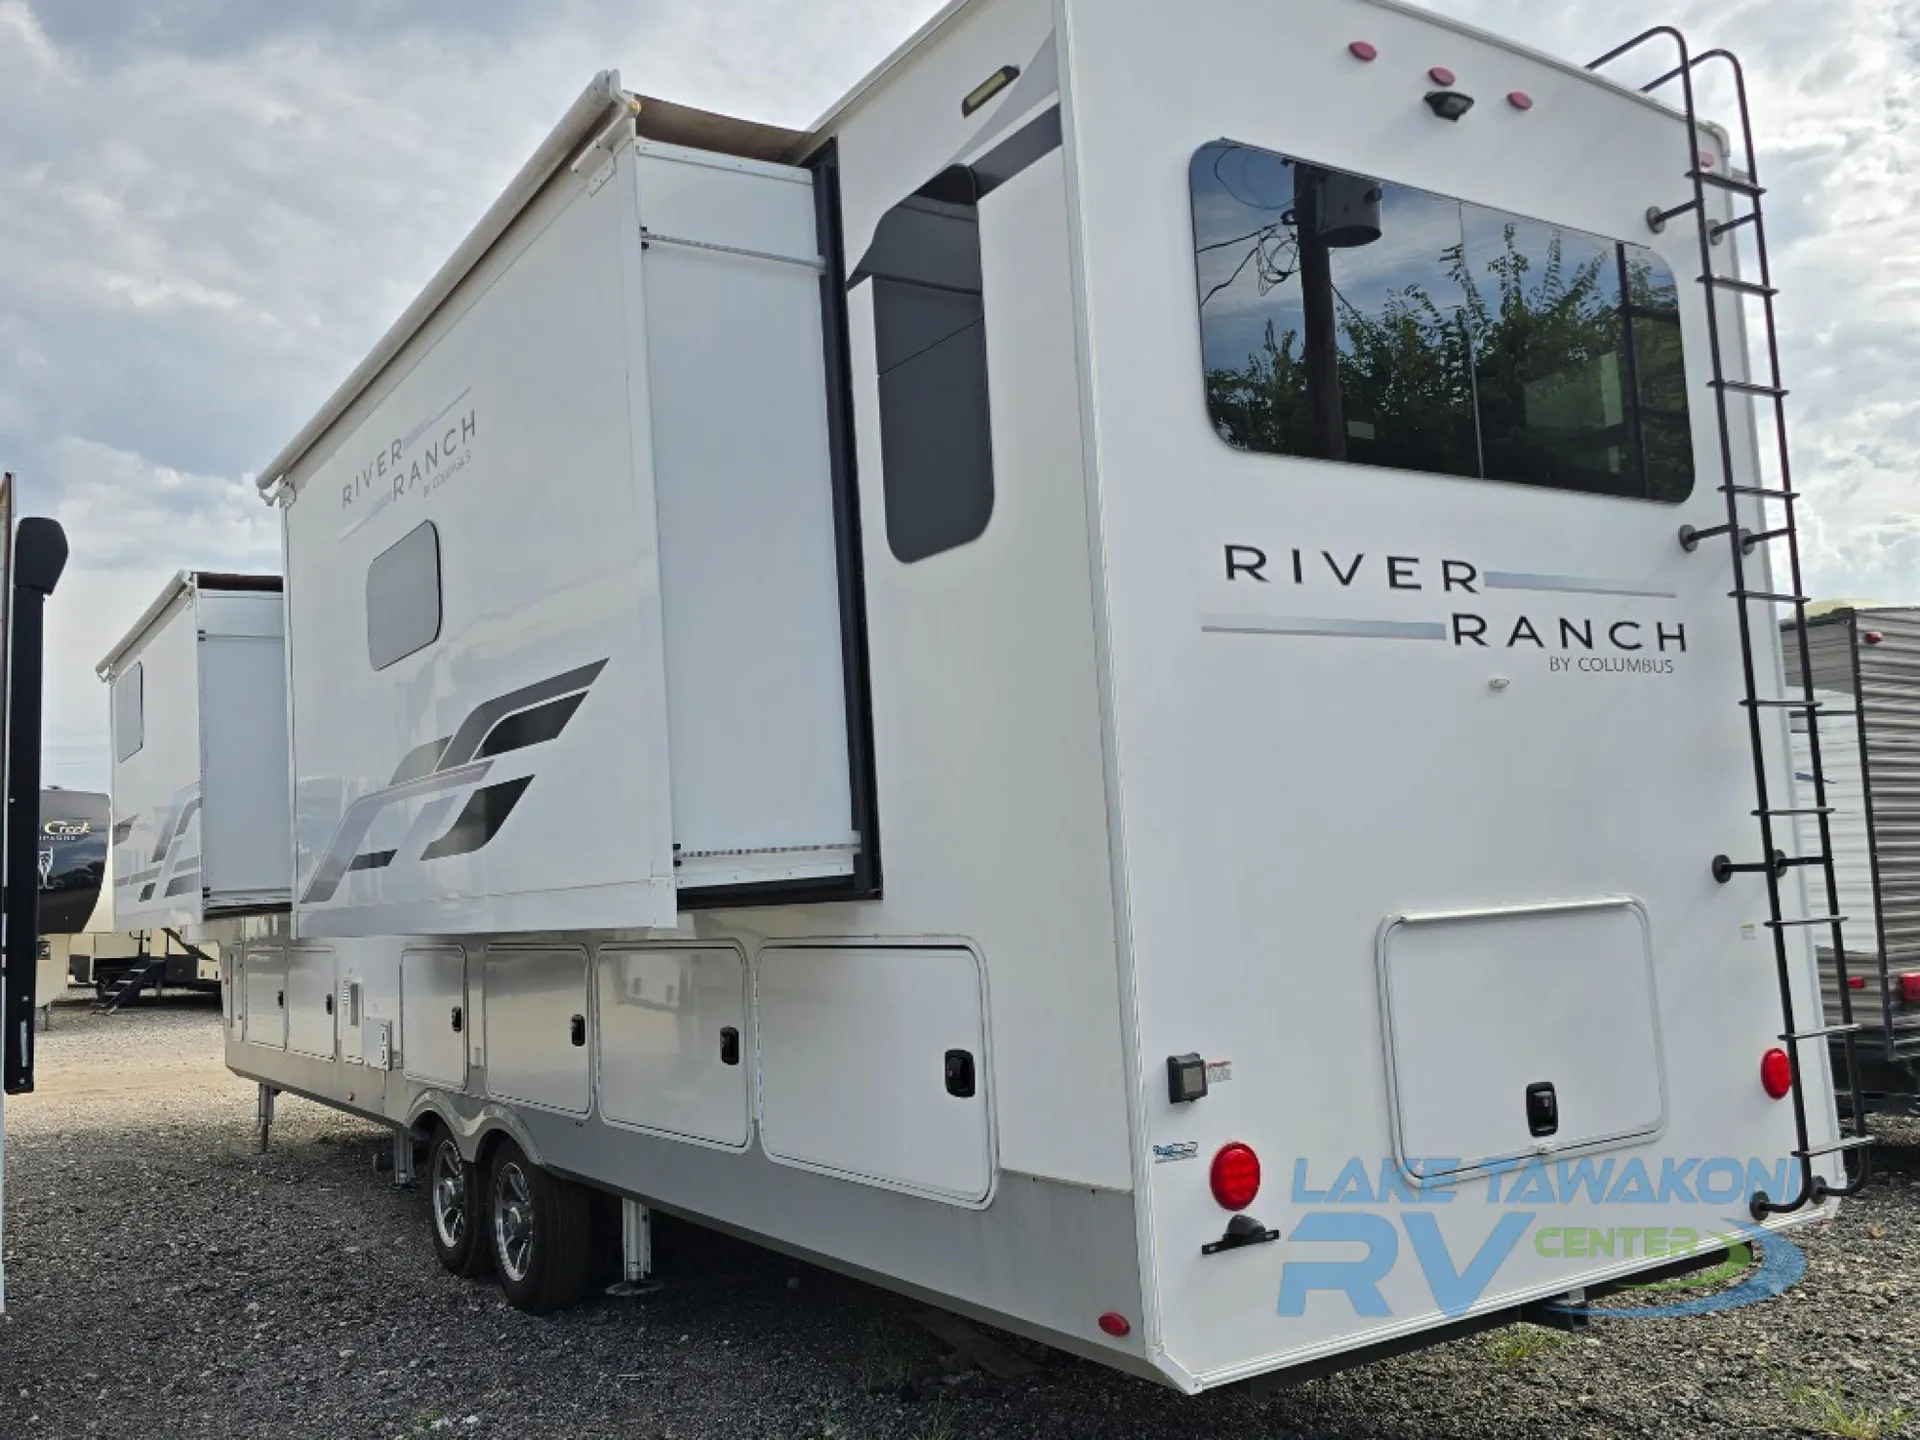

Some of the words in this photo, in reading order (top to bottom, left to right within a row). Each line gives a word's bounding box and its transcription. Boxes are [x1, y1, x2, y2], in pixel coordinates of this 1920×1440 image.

[342, 438, 402, 510] RIVER
[393, 408, 475, 502] RANCH
[1223, 543, 1481, 595] RIVER
[1451, 612, 1688, 653] RANCH
[1549, 656, 1571, 672] BY
[1578, 656, 1674, 674] COLUMBUS
